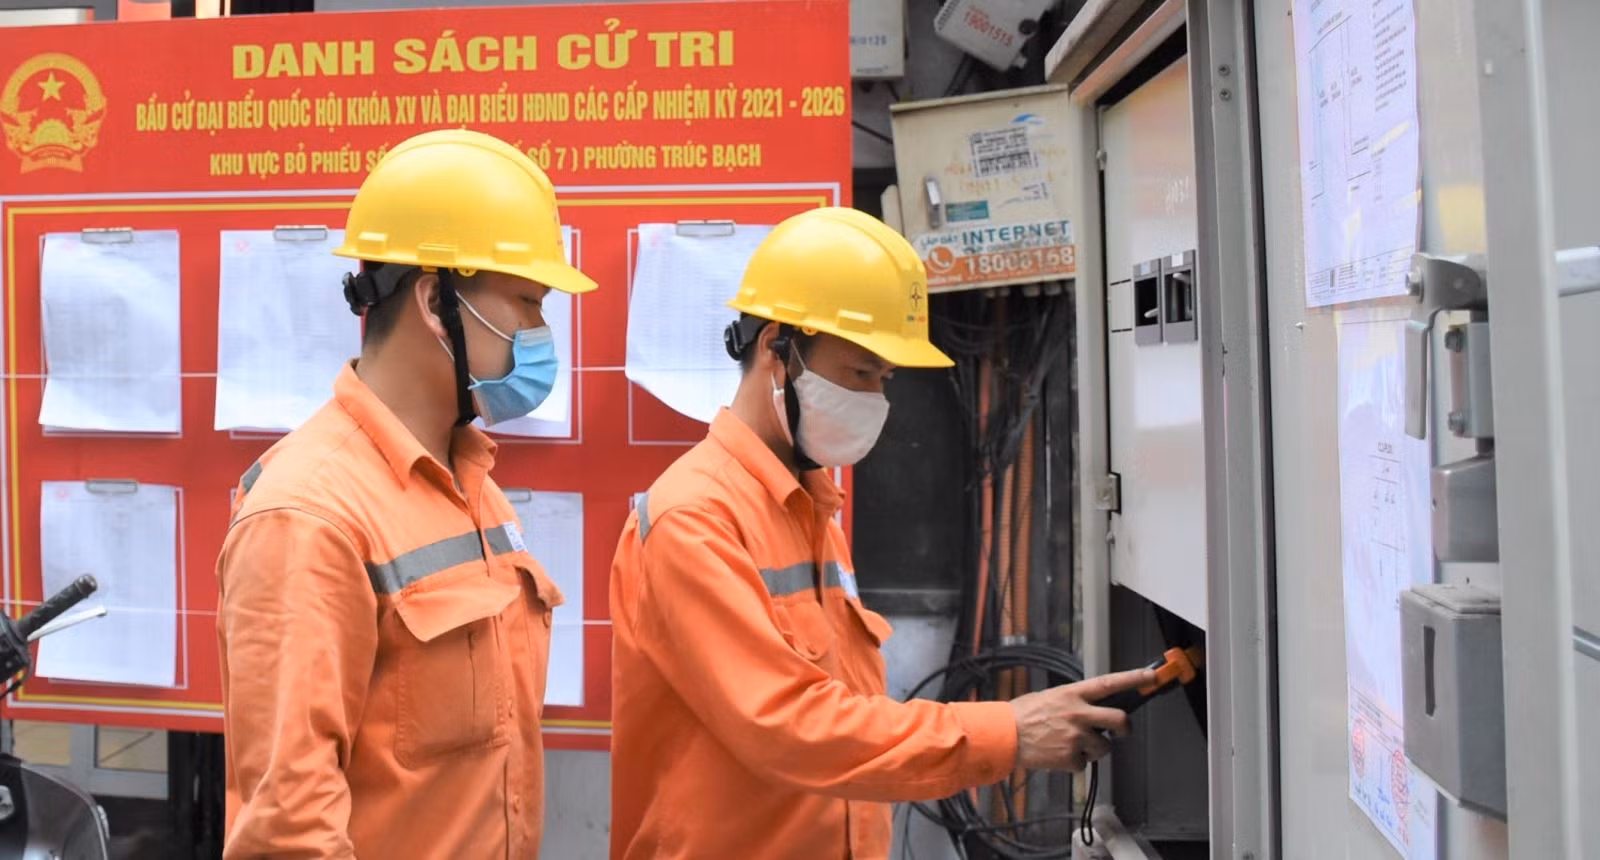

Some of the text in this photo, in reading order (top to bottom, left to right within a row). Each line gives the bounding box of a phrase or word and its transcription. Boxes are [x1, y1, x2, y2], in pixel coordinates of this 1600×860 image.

[232, 17, 735, 80] DANH SÁCH CỬ TRI
[171, 89, 196, 131] CỬ
[196, 100, 224, 136] ĐẠI
[227, 88, 265, 129] BIỂU
[267, 88, 312, 130] QUỐC
[314, 91, 343, 133] HỘI
[346, 90, 392, 127] KHÓA
[394, 95, 417, 125] XV
[420, 88, 444, 125] VÀ
[446, 94, 475, 131] ĐẠI
[479, 81, 519, 124] BIỂU
[522, 91, 571, 123] HĐND
[573, 84, 610, 122] CÁC
[613, 79, 649, 122] CẤP
[652, 82, 711, 126] NHIỆM
[714, 82, 738, 119] KỲ
[742, 87, 783, 119] 2021
[789, 100, 798, 109] -
[801, 85, 846, 117] 2026
[209, 152, 244, 177] KHU
[246, 149, 281, 180] VỰC
[283, 142, 308, 175] BỎ
[310, 143, 362, 174] PHIẾU
[554, 146, 567, 171] 7
[583, 139, 657, 170] PHƯỜNG
[660, 139, 708, 169] TRÚC
[711, 143, 762, 173] BẠCH
[962, 220, 1070, 246] INTERNET
